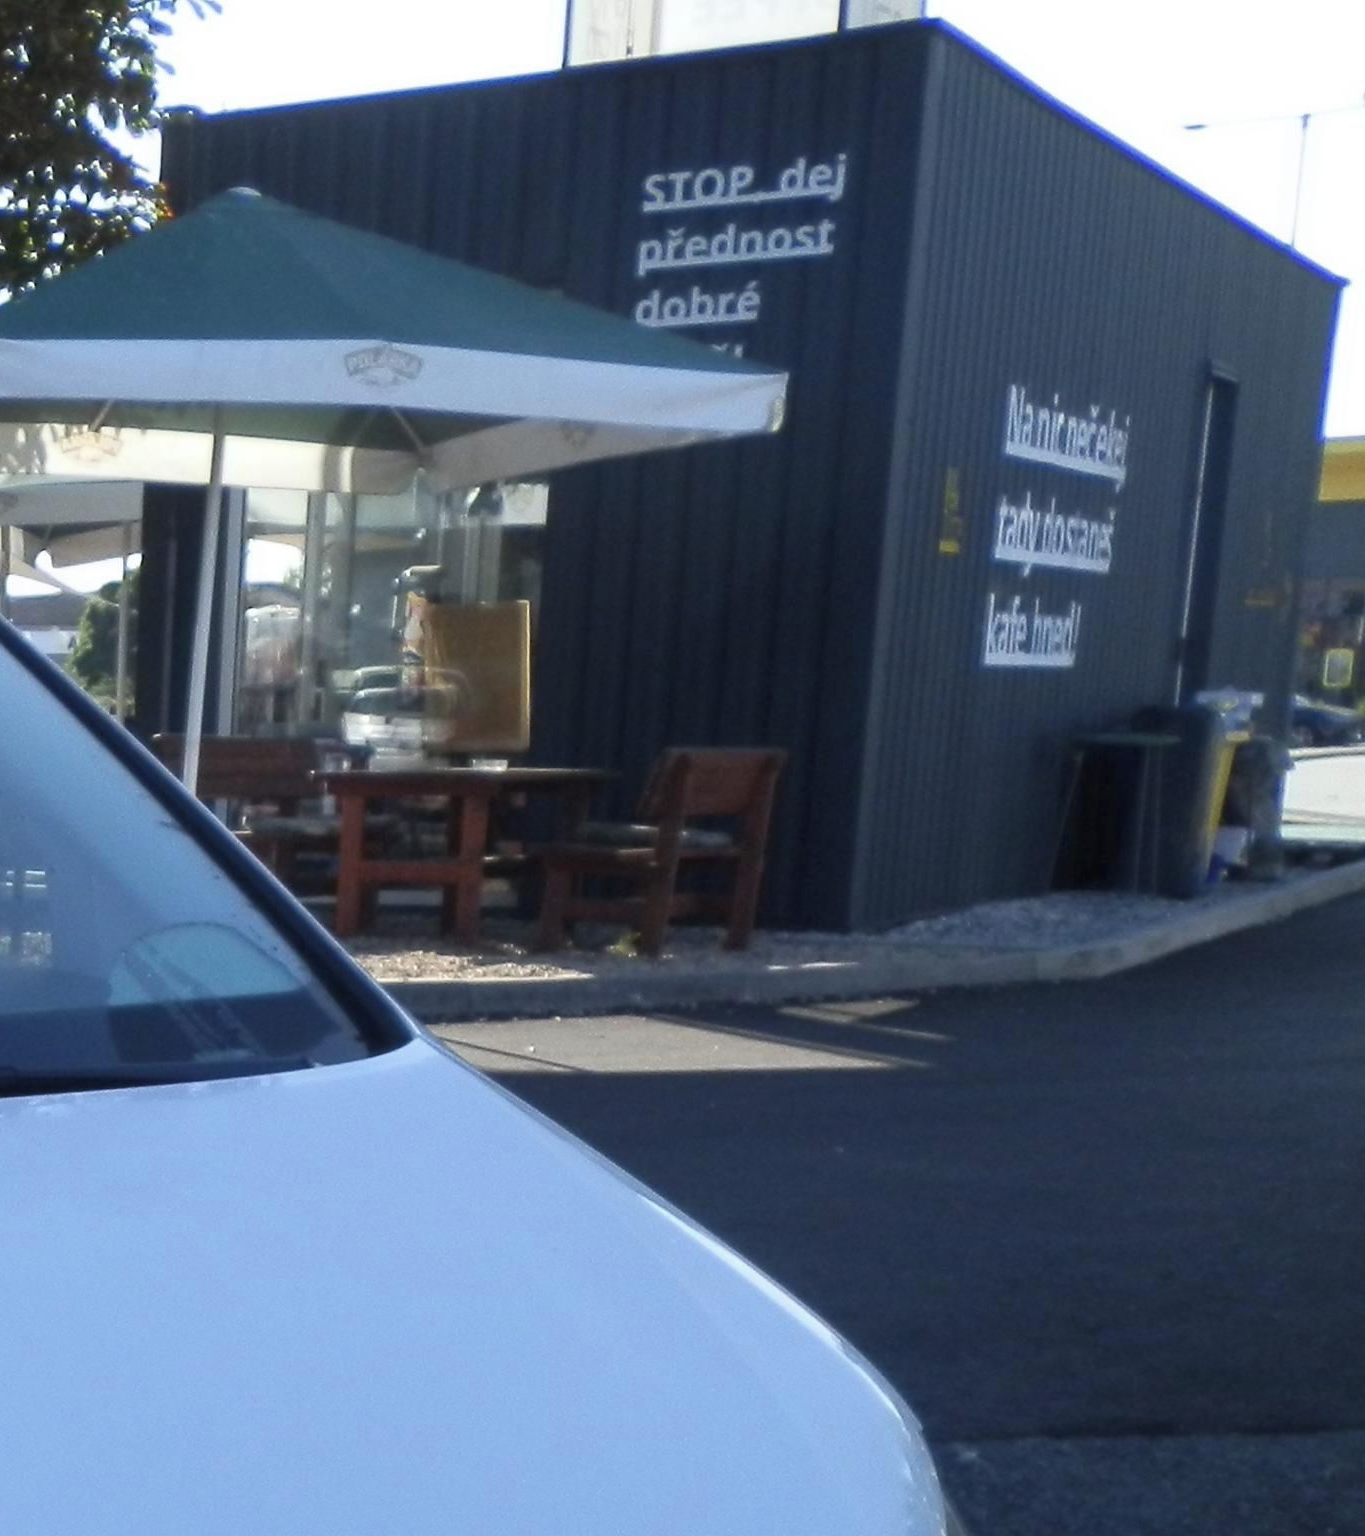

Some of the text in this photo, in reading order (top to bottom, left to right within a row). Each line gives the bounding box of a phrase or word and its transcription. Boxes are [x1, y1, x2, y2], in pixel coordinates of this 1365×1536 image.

[780, 153, 847, 202] dej
[637, 218, 836, 277] přednost
[635, 281, 761, 328] dobré
[1006, 384, 1033, 458] Na
[995, 491, 1115, 577] tady dostaneš
[984, 593, 1082, 666] kafe hned!
